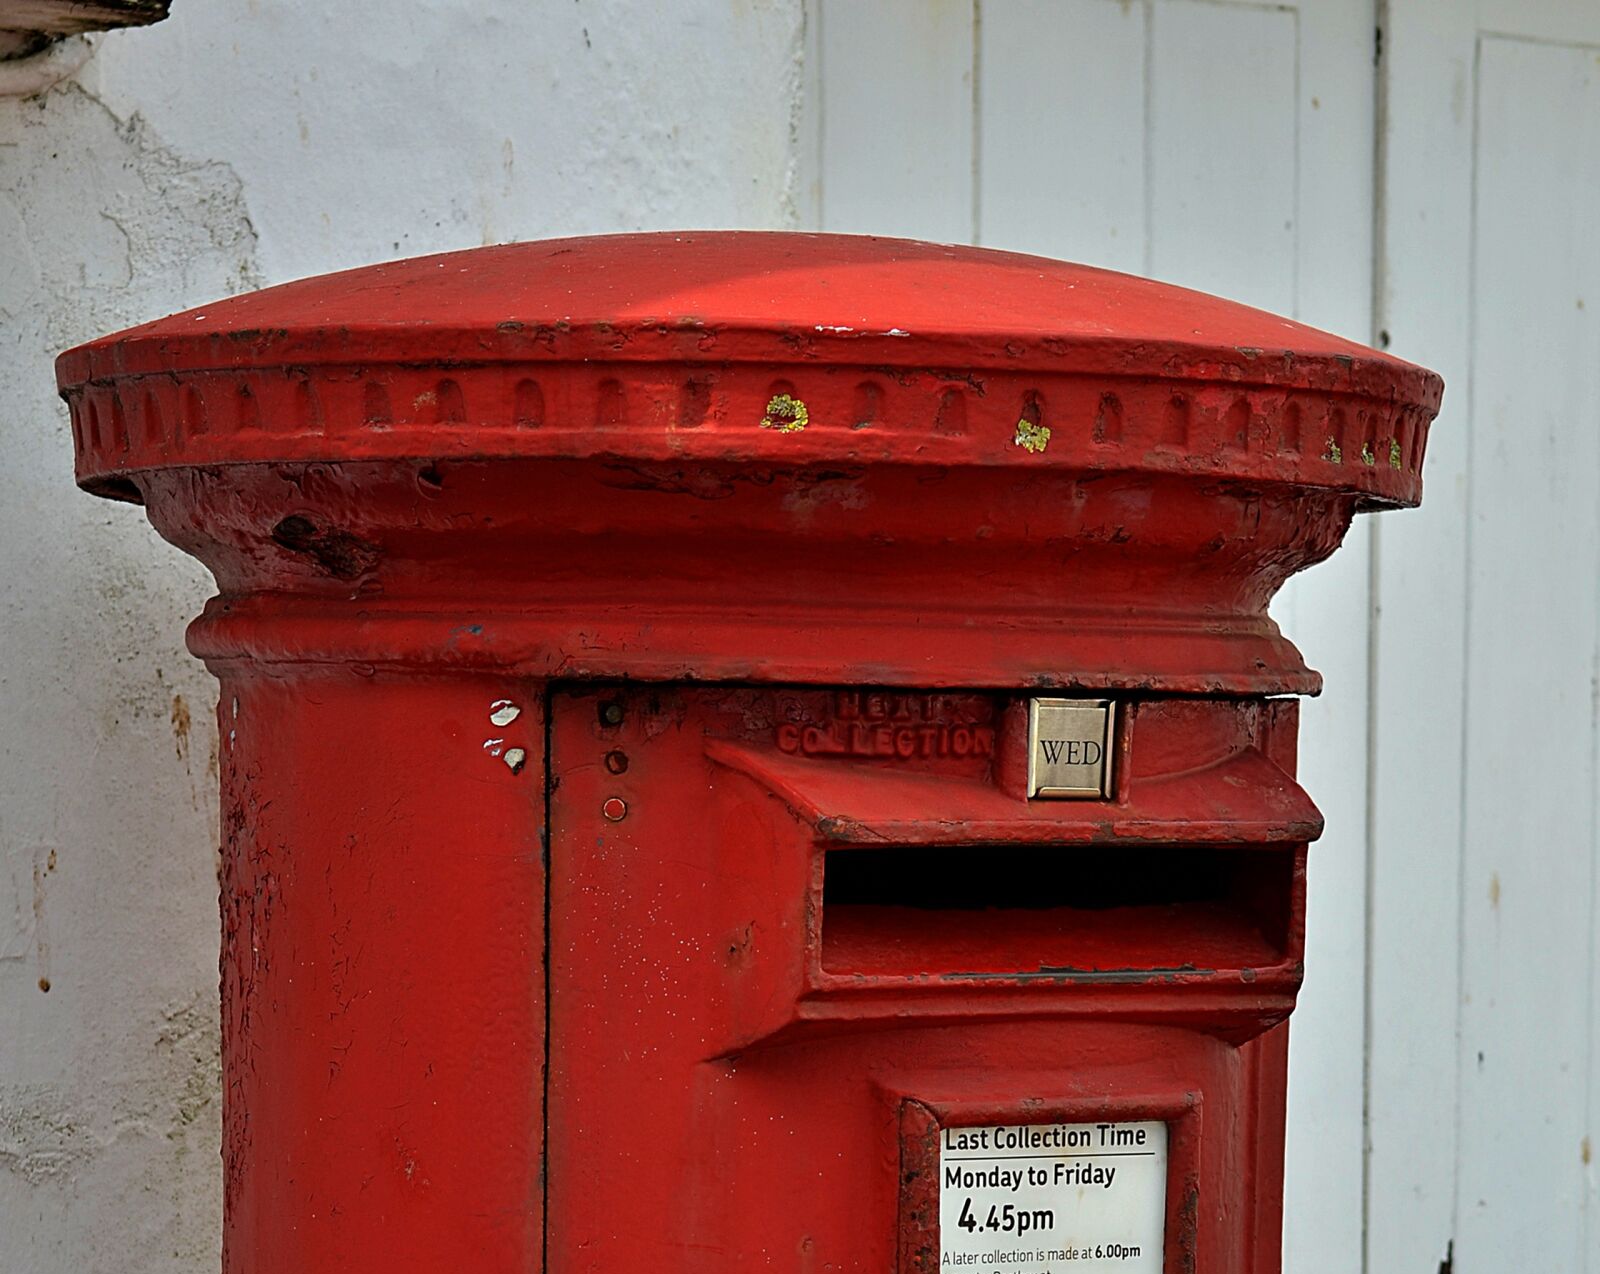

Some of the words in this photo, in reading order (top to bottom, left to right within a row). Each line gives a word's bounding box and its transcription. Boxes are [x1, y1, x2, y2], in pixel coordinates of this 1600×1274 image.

[778, 722, 995, 757] COLLECTION
[1041, 740, 1101, 766] WED
[945, 1127, 988, 1150] Last
[994, 1126, 1091, 1149] Collection
[1097, 1124, 1146, 1147] Time
[945, 1166, 1022, 1191] Monday
[1027, 1167, 1048, 1185] to
[1053, 1163, 1116, 1188] Friday
[958, 1197, 1054, 1237] 4.45pm
[942, 1252, 951, 1265] A
[953, 1250, 978, 1265] later
[981, 1248, 1034, 1264] collection
[1036, 1248, 1045, 1261] is
[1048, 1246, 1079, 1261] made
[1081, 1246, 1093, 1259] at
[1095, 1244, 1141, 1261] 6.00pm
